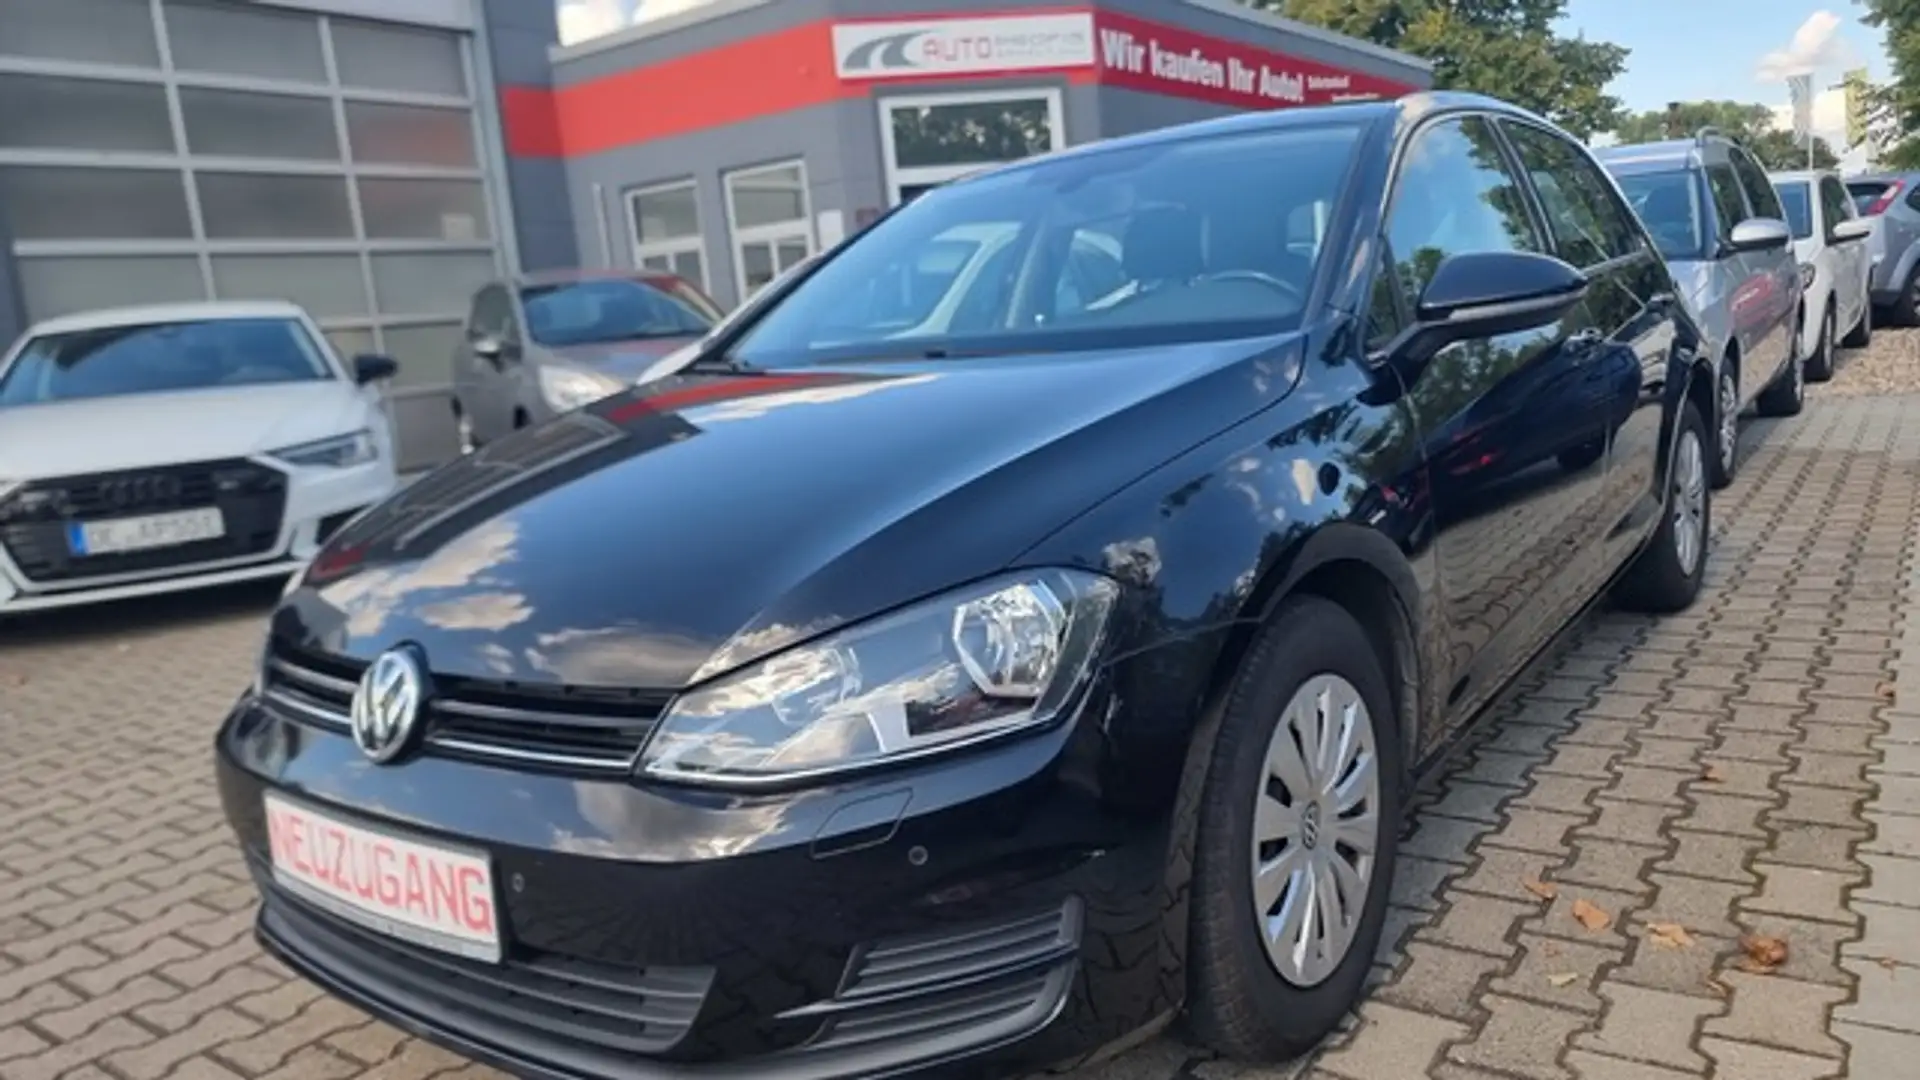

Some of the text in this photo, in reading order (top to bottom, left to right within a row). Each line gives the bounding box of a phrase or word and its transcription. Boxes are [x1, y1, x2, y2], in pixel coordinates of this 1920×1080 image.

[923, 37, 992, 62] AUTO
[1101, 29, 1304, 103] Wir kaufen Ihr Auto!
[268, 809, 493, 933] NEUZUGANG
